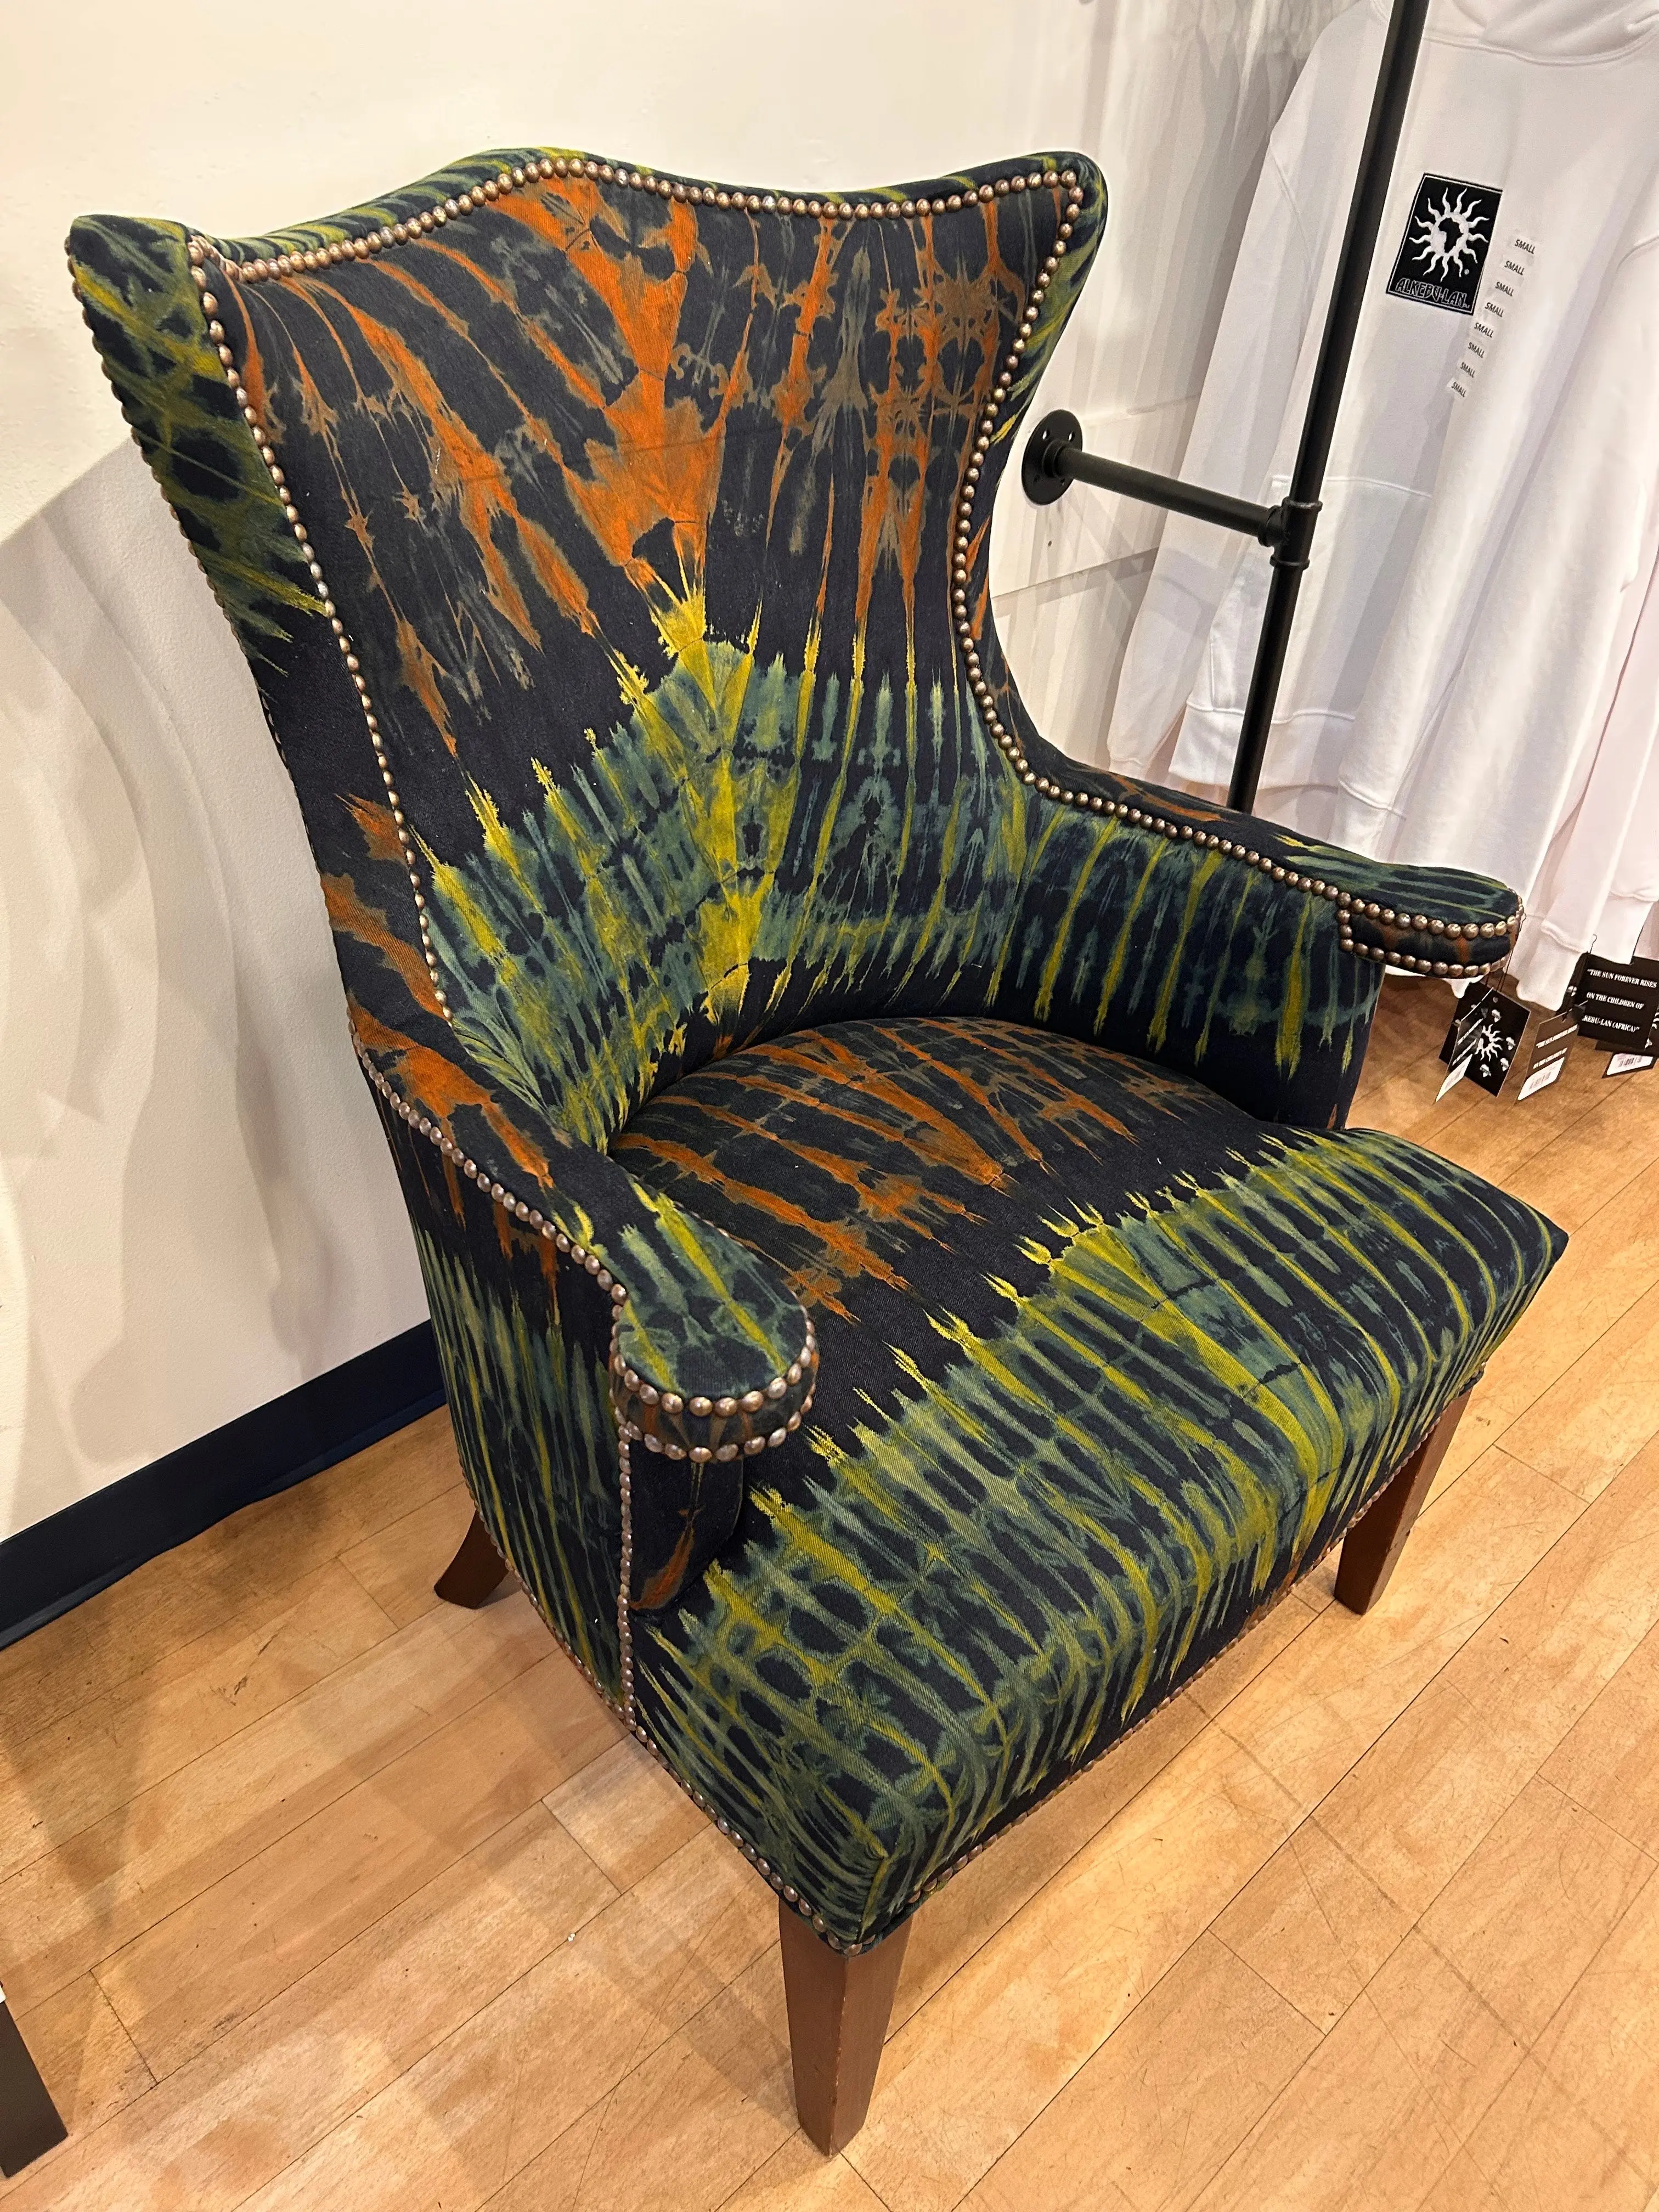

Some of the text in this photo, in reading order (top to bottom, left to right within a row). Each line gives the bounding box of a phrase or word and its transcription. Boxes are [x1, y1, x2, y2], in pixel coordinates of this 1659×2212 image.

[1515, 239, 1536, 254] SMALL
[1504, 261, 1525, 275] SMALL
[1495, 281, 1514, 297] SMALL
[1485, 302, 1504, 318] SMALL
[1474, 322, 1493, 338] SMALL
[1468, 342, 1485, 358] SMALL
[1460, 362, 1475, 378] SMALL
[1451, 382, 1466, 398] SMALL
[1601, 972, 1615, 980] SUN
[1614, 974, 1640, 985] FOREVER
[1640, 979, 1657, 988] RISES
[1595, 994, 1607, 1002] THE
[1607, 996, 1635, 1008] CHILDREN
[1582, 1015, 1612, 1027] KEBU-LAN
